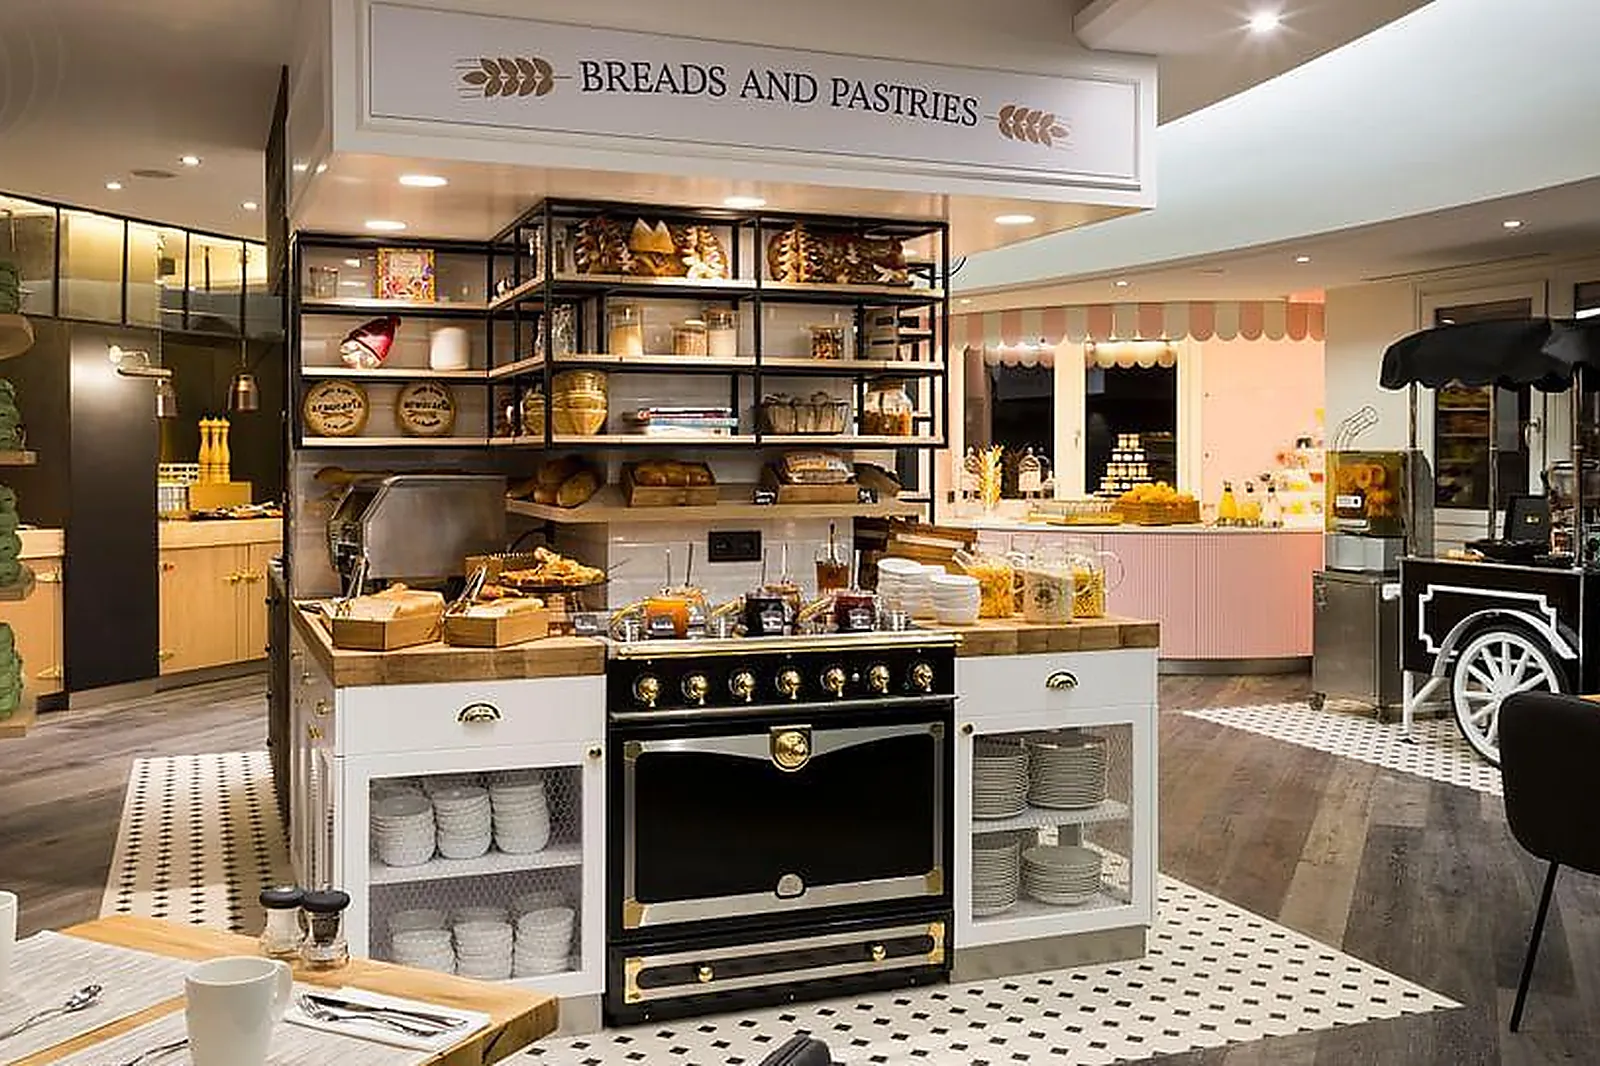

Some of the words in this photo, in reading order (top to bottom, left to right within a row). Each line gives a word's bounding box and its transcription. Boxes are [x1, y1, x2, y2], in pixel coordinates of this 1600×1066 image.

[579, 60, 727, 98] BREADS
[739, 68, 818, 104] AND
[831, 77, 978, 127] PASTRIES
